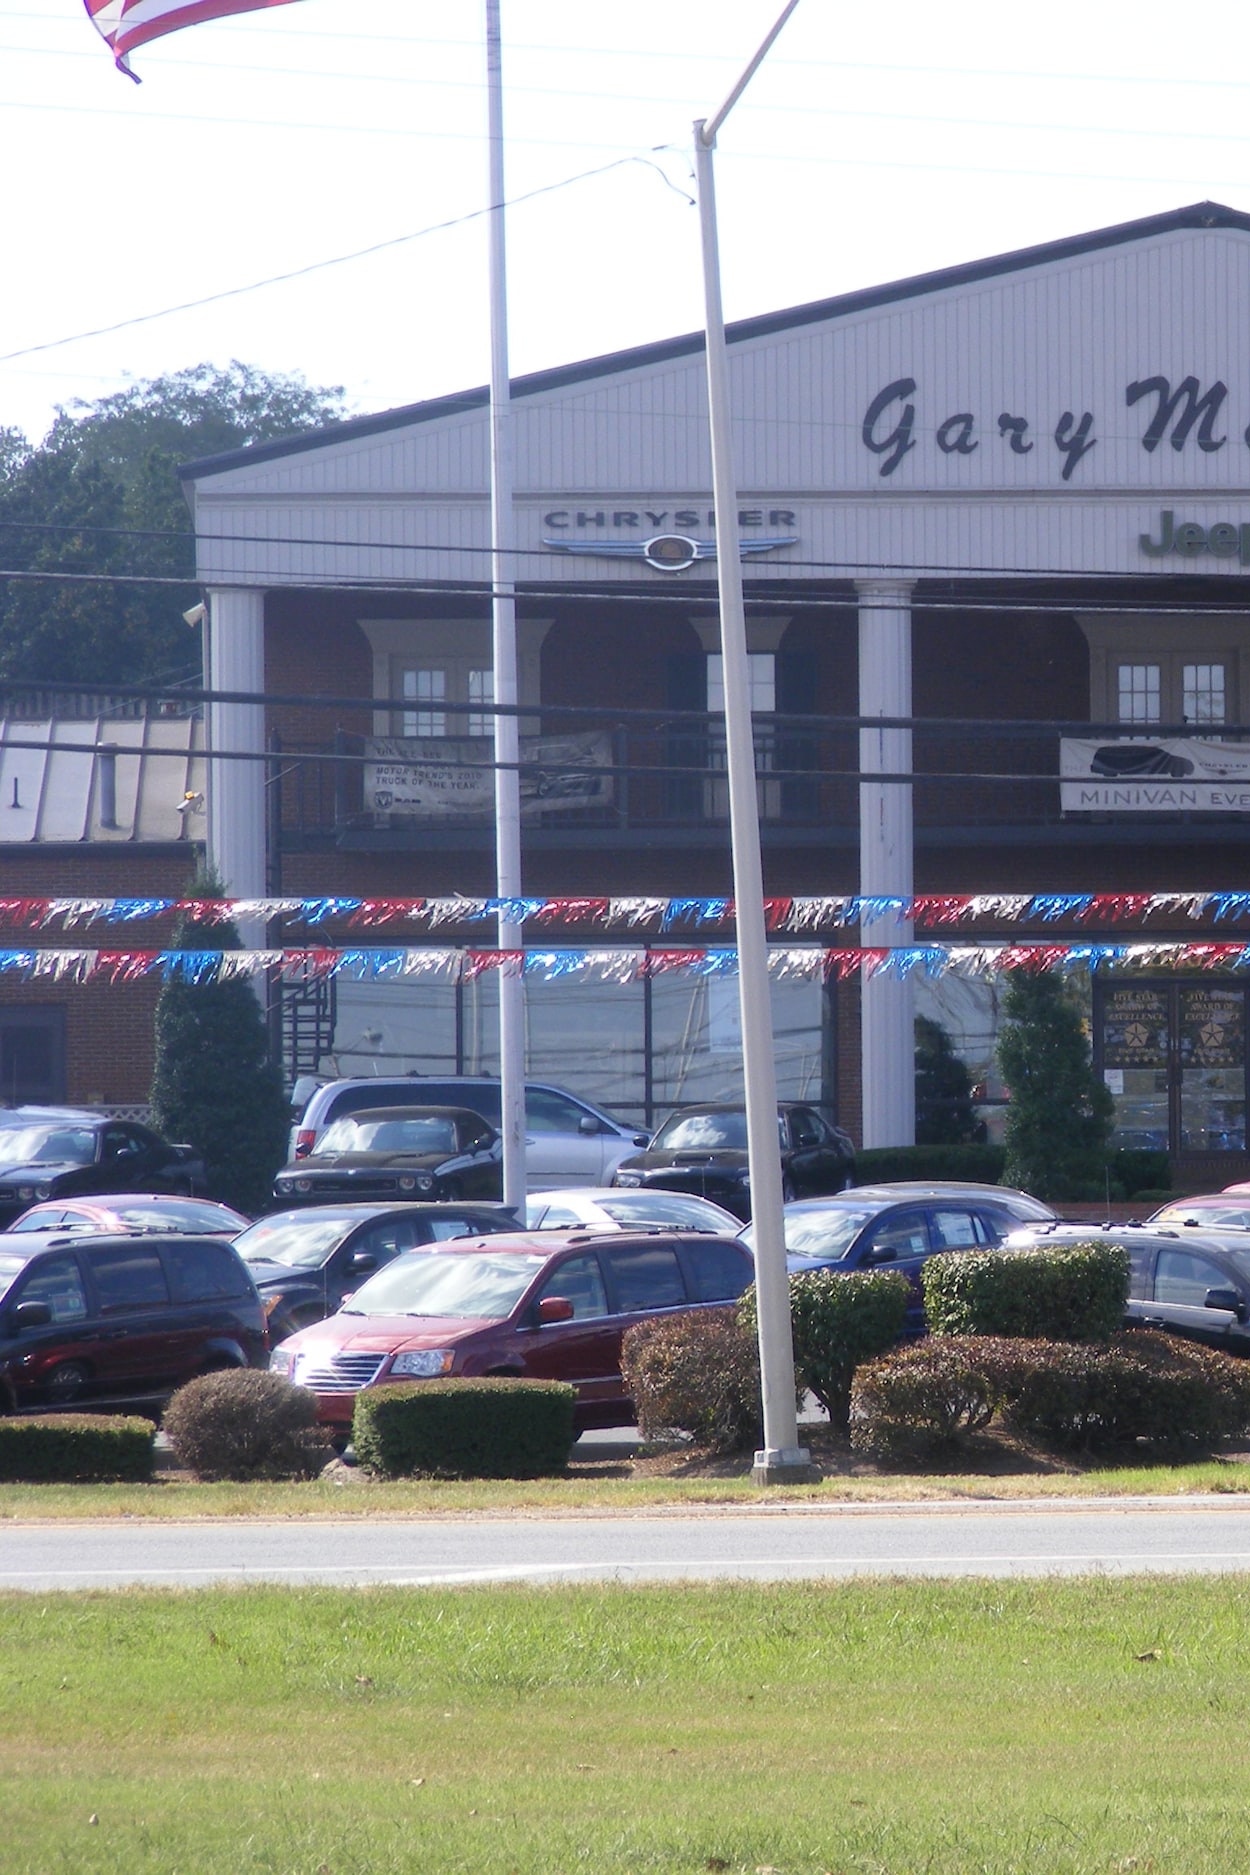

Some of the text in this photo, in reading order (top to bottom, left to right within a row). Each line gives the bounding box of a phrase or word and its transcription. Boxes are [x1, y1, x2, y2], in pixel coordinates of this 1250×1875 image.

[862, 377, 1097, 480] Gary
[544, 509, 796, 528] CHRYSLER
[376, 767, 410, 777] MOTOR
[375, 776, 409, 786] TRUCK
[427, 779, 448, 790] THE
[1080, 789, 1197, 805] MINIVAN
